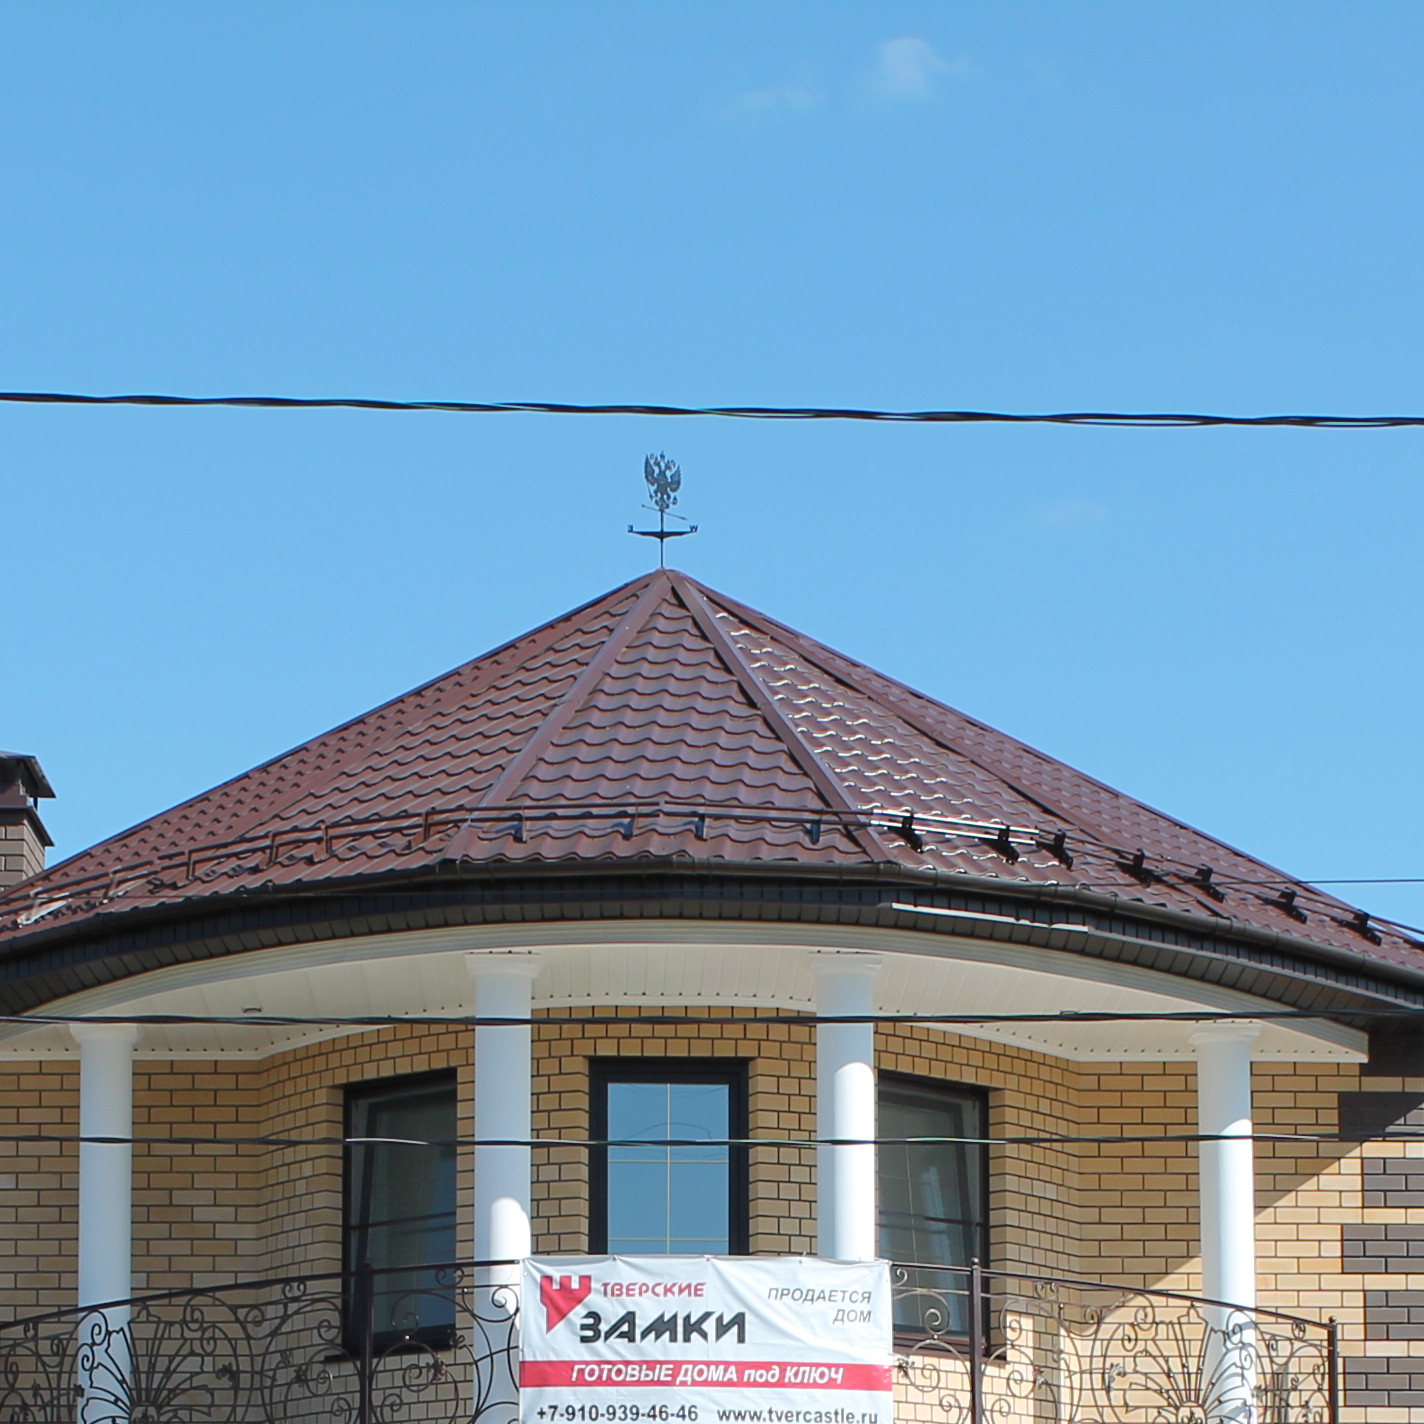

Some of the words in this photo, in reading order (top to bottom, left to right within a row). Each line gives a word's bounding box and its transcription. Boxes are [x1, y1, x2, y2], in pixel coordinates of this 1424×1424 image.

[601, 1282, 706, 1298] ТВЕРСКИЕ
[767, 1287, 872, 1304] ПРОДАЕТСЯ
[832, 1309, 872, 1325] ДОМ
[579, 1311, 746, 1344] ЗАМКИ
[571, 1363, 672, 1382] ГОТОВЫЕ
[676, 1366, 738, 1385] ДОМА
[744, 1367, 779, 1383] под
[784, 1367, 843, 1384] КЛЮЧ
[537, 1405, 699, 1422] +7-910-939-46-46
[717, 1409, 878, 1424] www.tvercastle.ru
